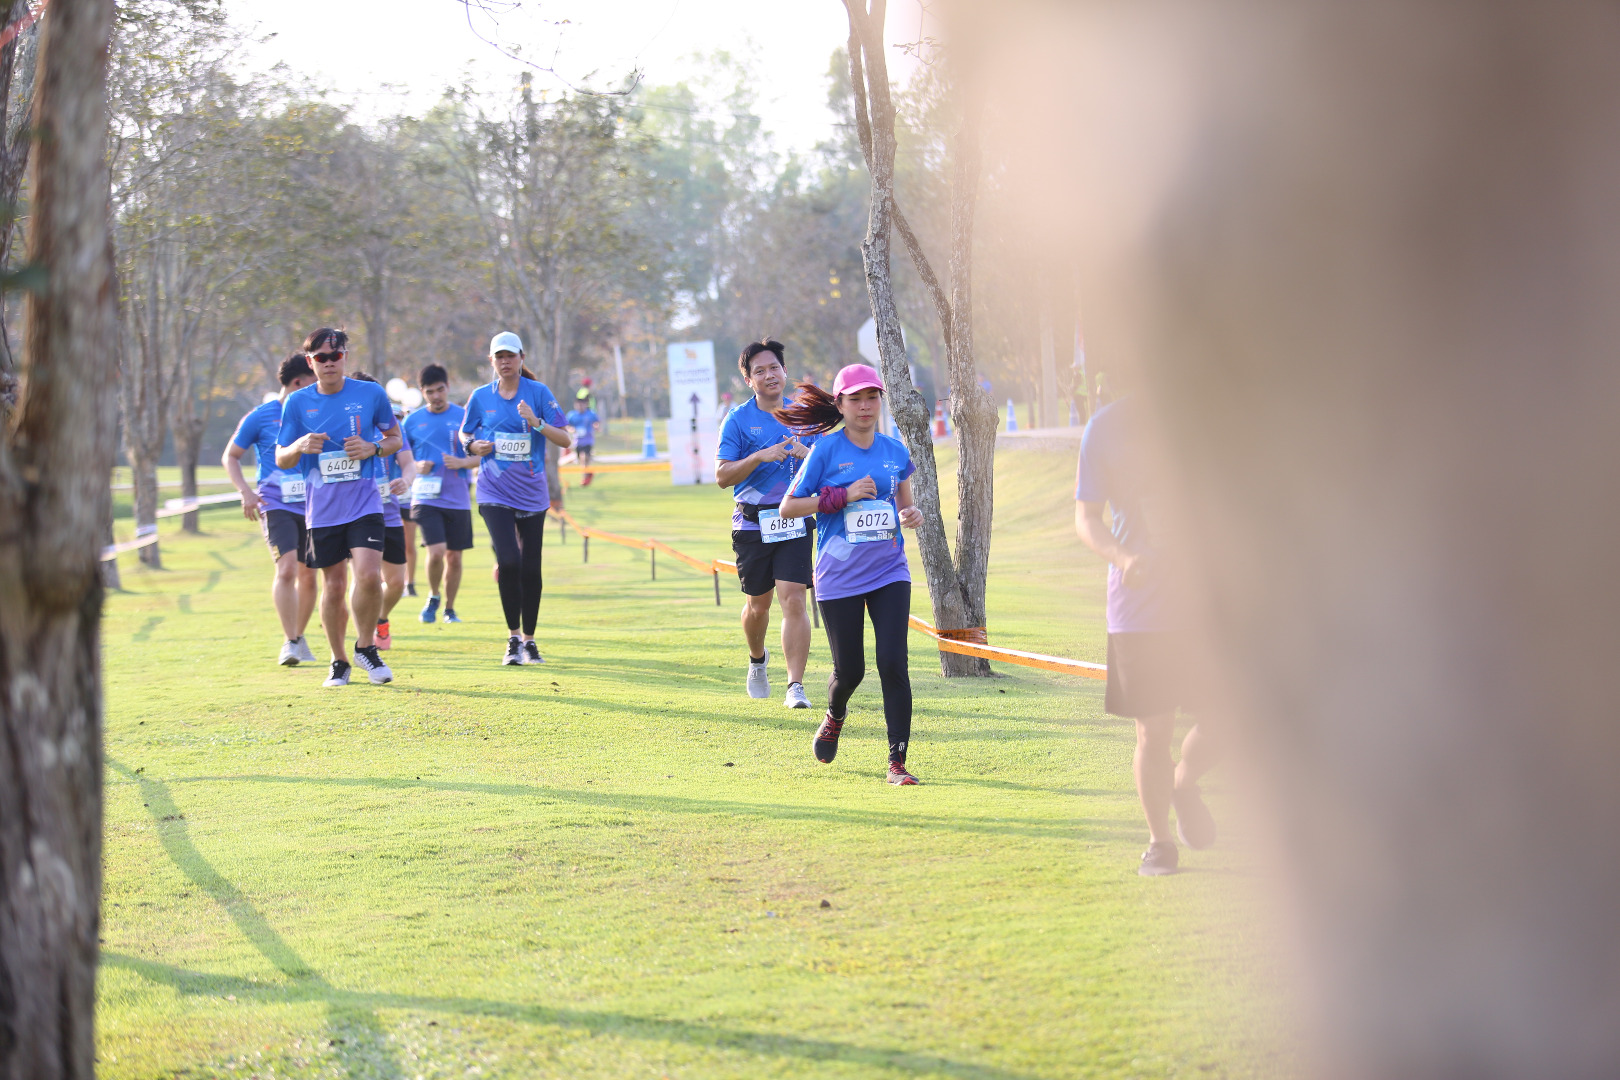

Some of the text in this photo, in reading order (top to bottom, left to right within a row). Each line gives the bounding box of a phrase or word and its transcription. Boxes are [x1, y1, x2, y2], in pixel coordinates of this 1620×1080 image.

[501, 441, 526, 452] 6009
[327, 459, 355, 472] 6402
[291, 482, 304, 493] 611
[770, 517, 795, 531] 6183
[856, 512, 889, 528] 6072
